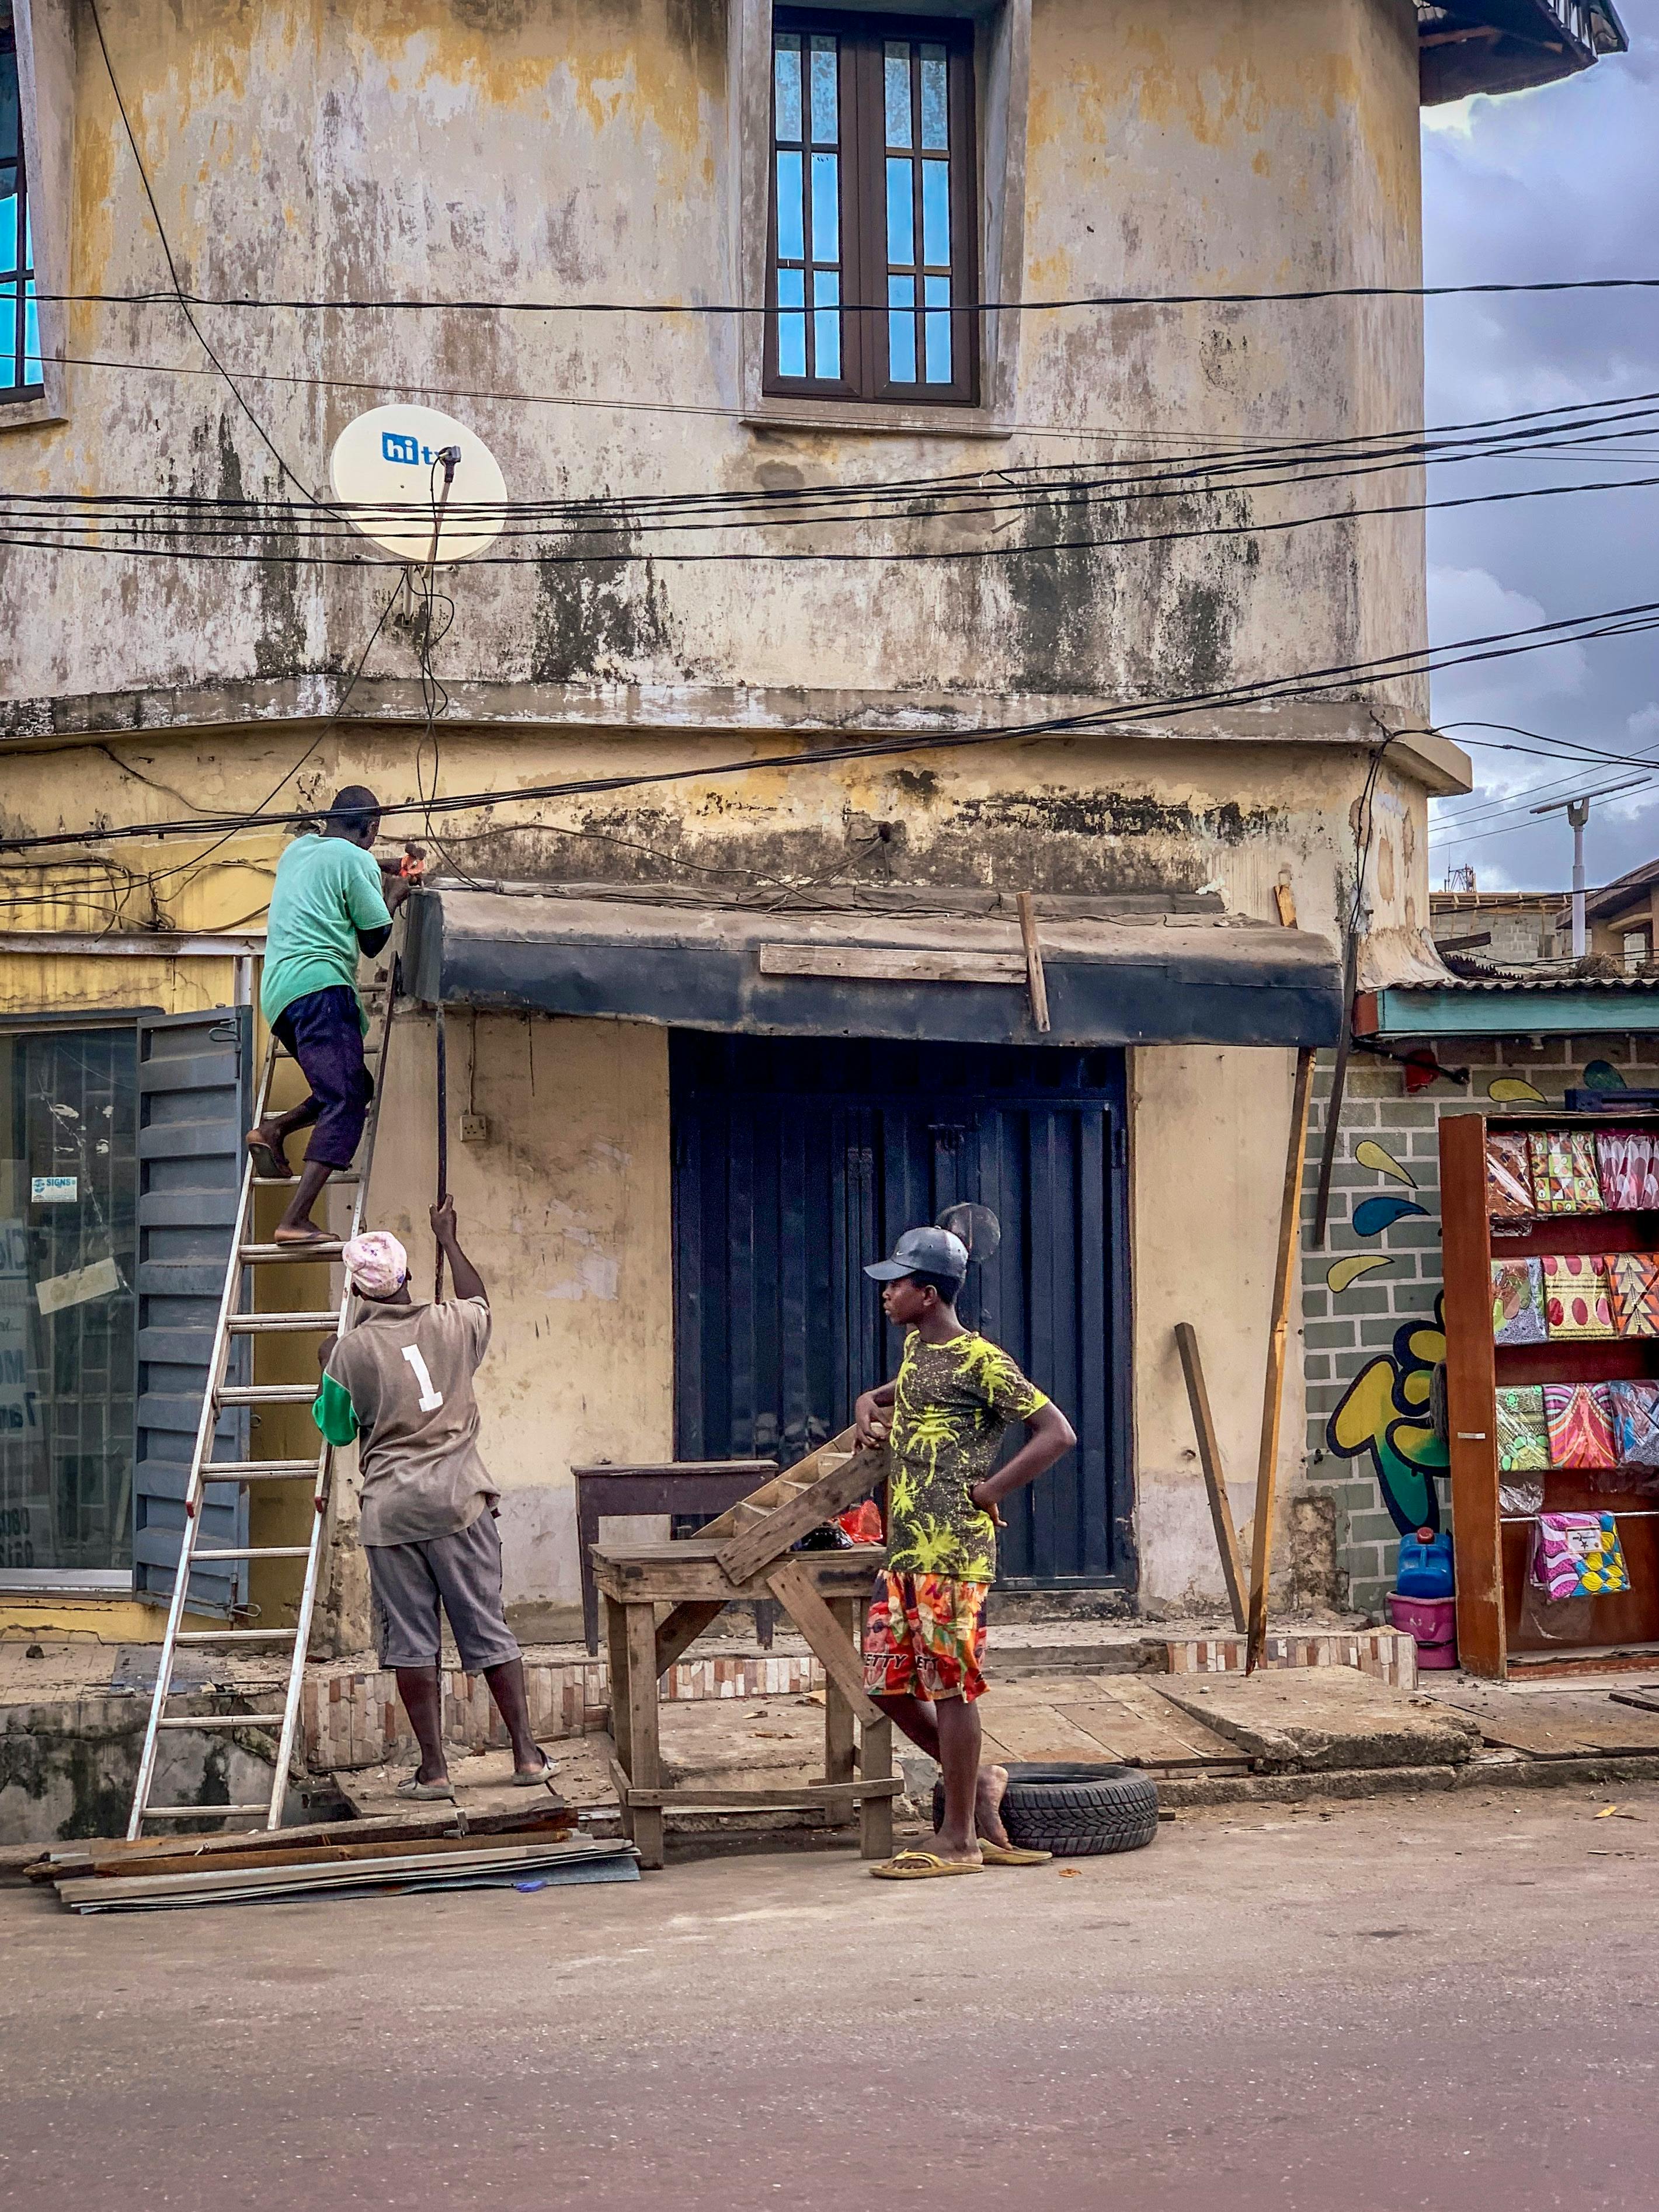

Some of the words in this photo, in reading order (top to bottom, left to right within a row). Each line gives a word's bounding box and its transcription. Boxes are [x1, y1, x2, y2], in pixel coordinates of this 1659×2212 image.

[387, 439, 413, 461] hi
[46, 1178, 71, 1187] SIGNS
[401, 1344, 443, 1412] 1
